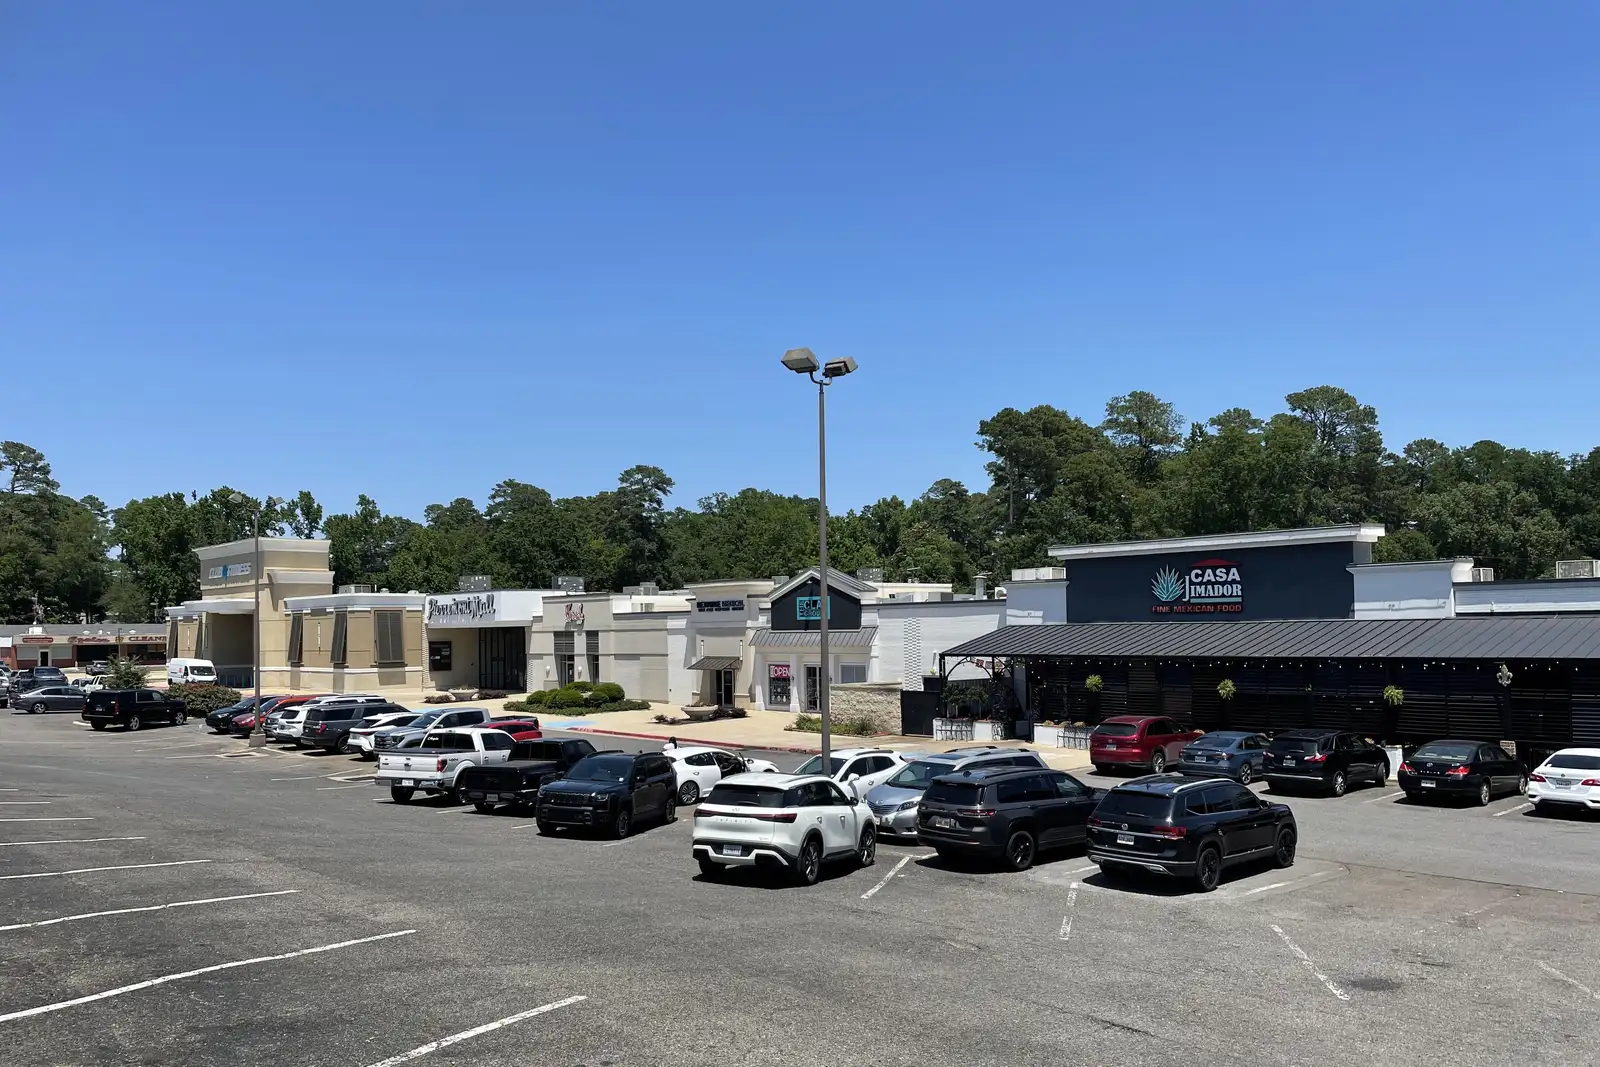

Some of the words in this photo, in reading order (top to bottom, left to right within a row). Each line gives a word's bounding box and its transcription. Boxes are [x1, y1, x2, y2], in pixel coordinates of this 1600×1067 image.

[1190, 568, 1241, 583] CASA
[1182, 575, 1242, 602] JIMADOR
[803, 600, 821, 610] CLA
[1152, 605, 1171, 613] FINE
[1173, 604, 1214, 613] MEXICAN
[1217, 604, 1242, 612] FOOD
[773, 667, 791, 677] OPEN
